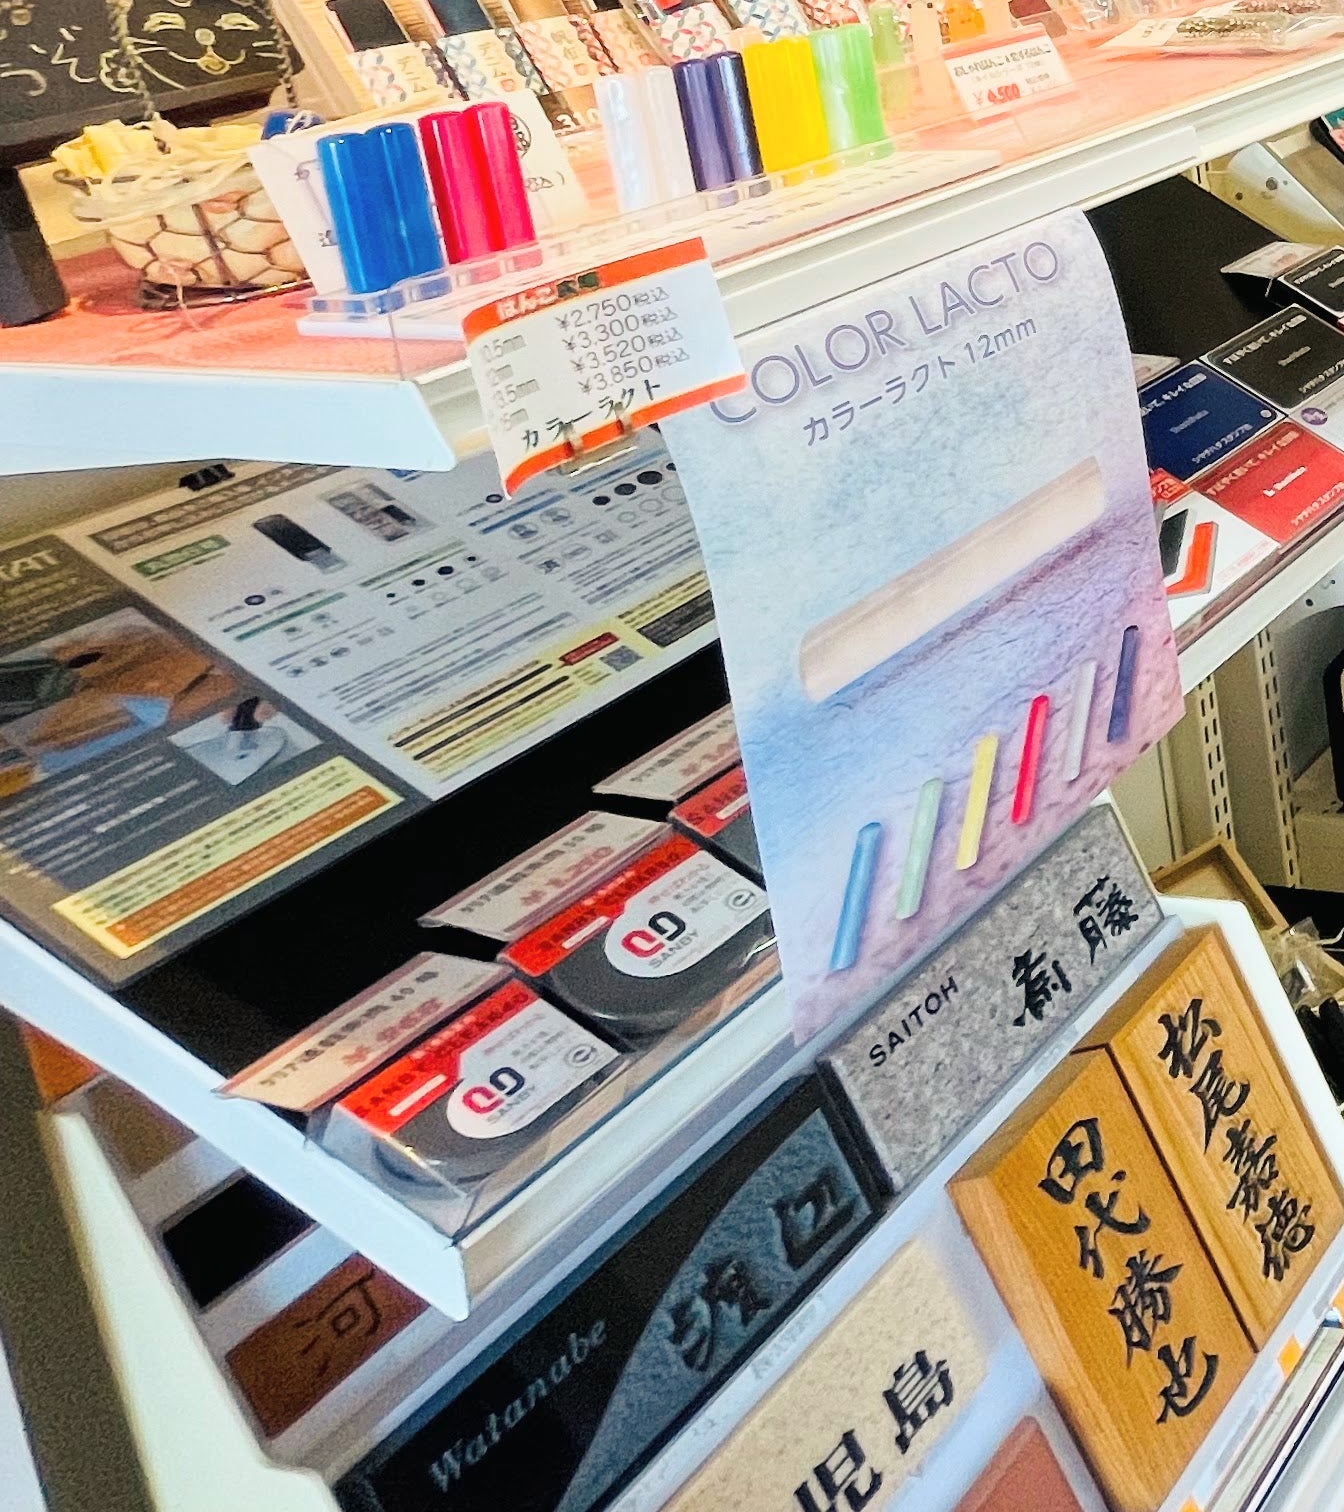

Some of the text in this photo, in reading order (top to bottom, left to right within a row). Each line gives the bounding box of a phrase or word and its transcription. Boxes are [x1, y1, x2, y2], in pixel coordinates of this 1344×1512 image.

[708, 238, 1061, 427] COLOR LACTO
[802, 314, 1038, 448] カラーラクト 12mm
[521, 378, 661, 451] カラーラクト
[868, 976, 962, 1069] SAITOH
[1038, 1117, 1221, 1427] 田代勝也
[425, 1317, 611, 1494] Watanabe
